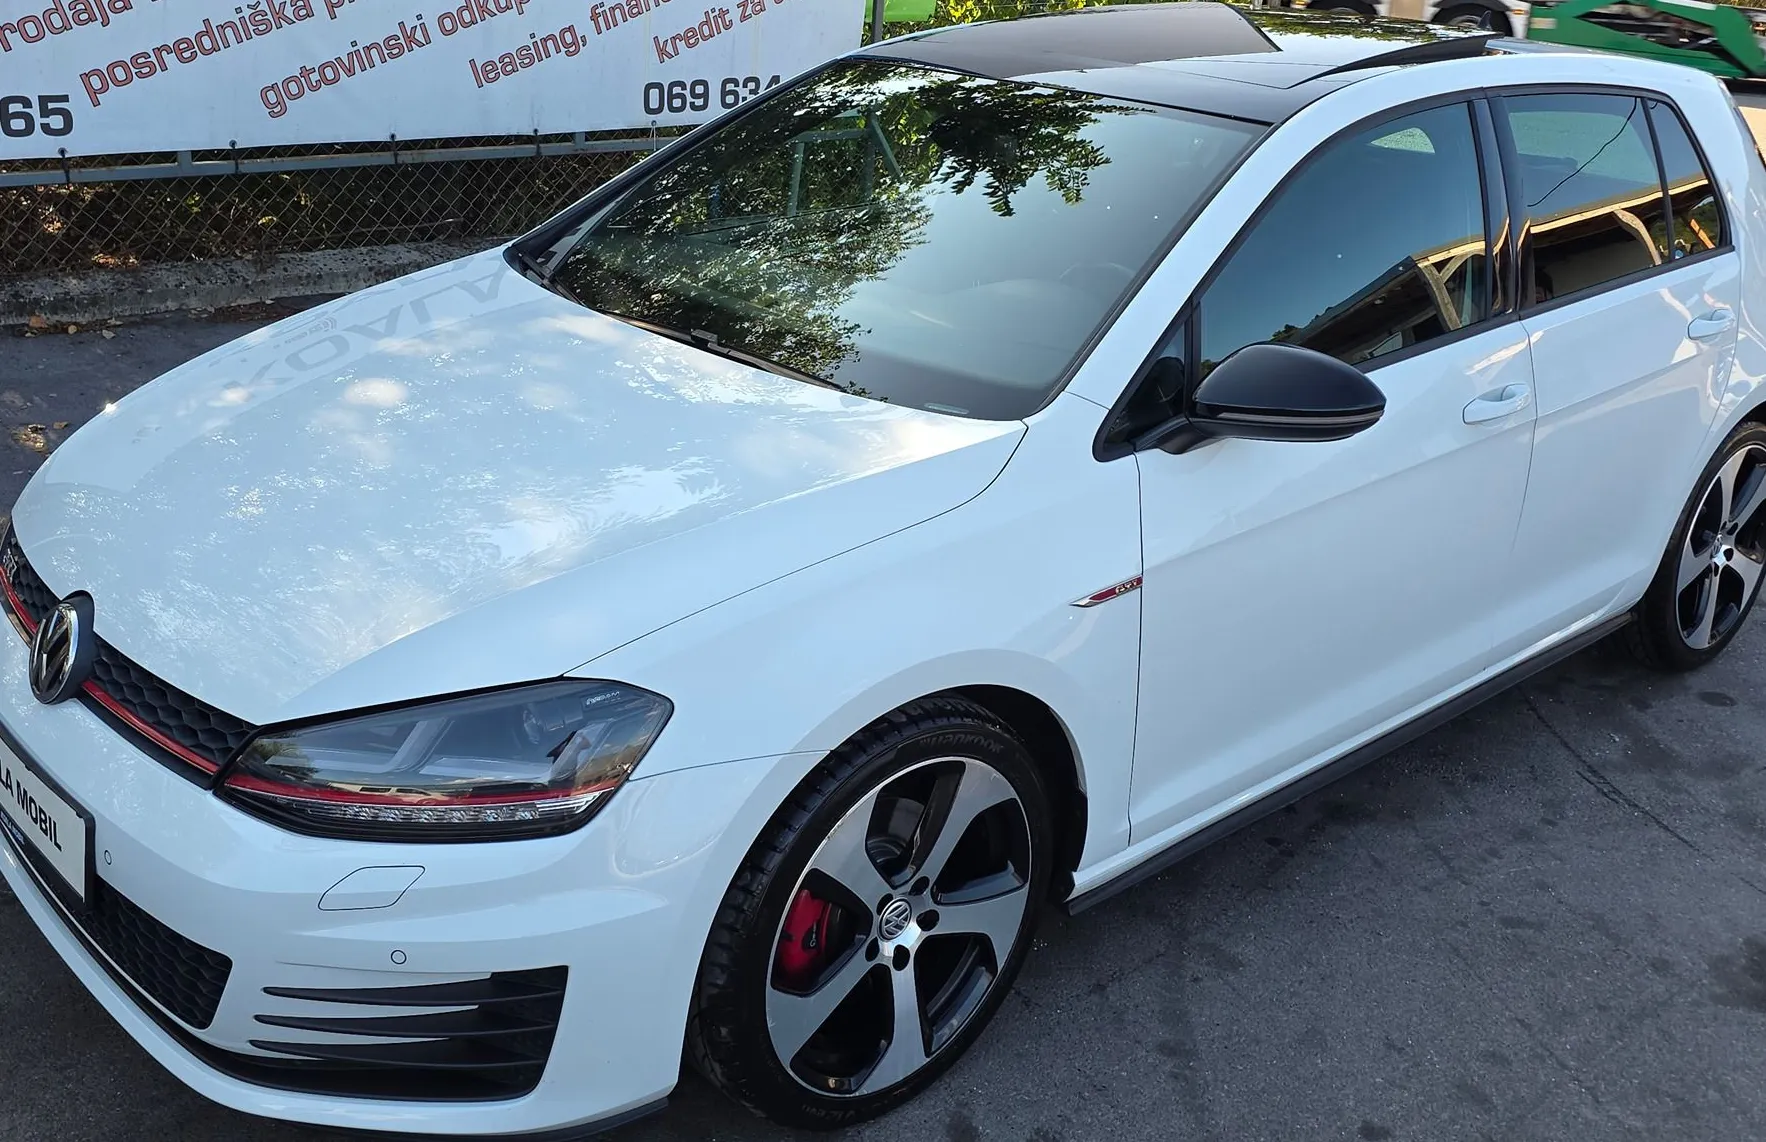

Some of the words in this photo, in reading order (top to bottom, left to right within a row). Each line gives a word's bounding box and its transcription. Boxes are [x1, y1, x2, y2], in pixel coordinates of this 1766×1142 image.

[79, 0, 315, 107] posredniška
[469, 25, 587, 89] leasing,
[653, 7, 733, 64] kredit
[737, 0, 766, 23] za
[260, 14, 431, 119] gotovinski
[643, 78, 709, 115] 069
[0, 94, 74, 138] 65
[16, 778, 62, 852] MOBIL
